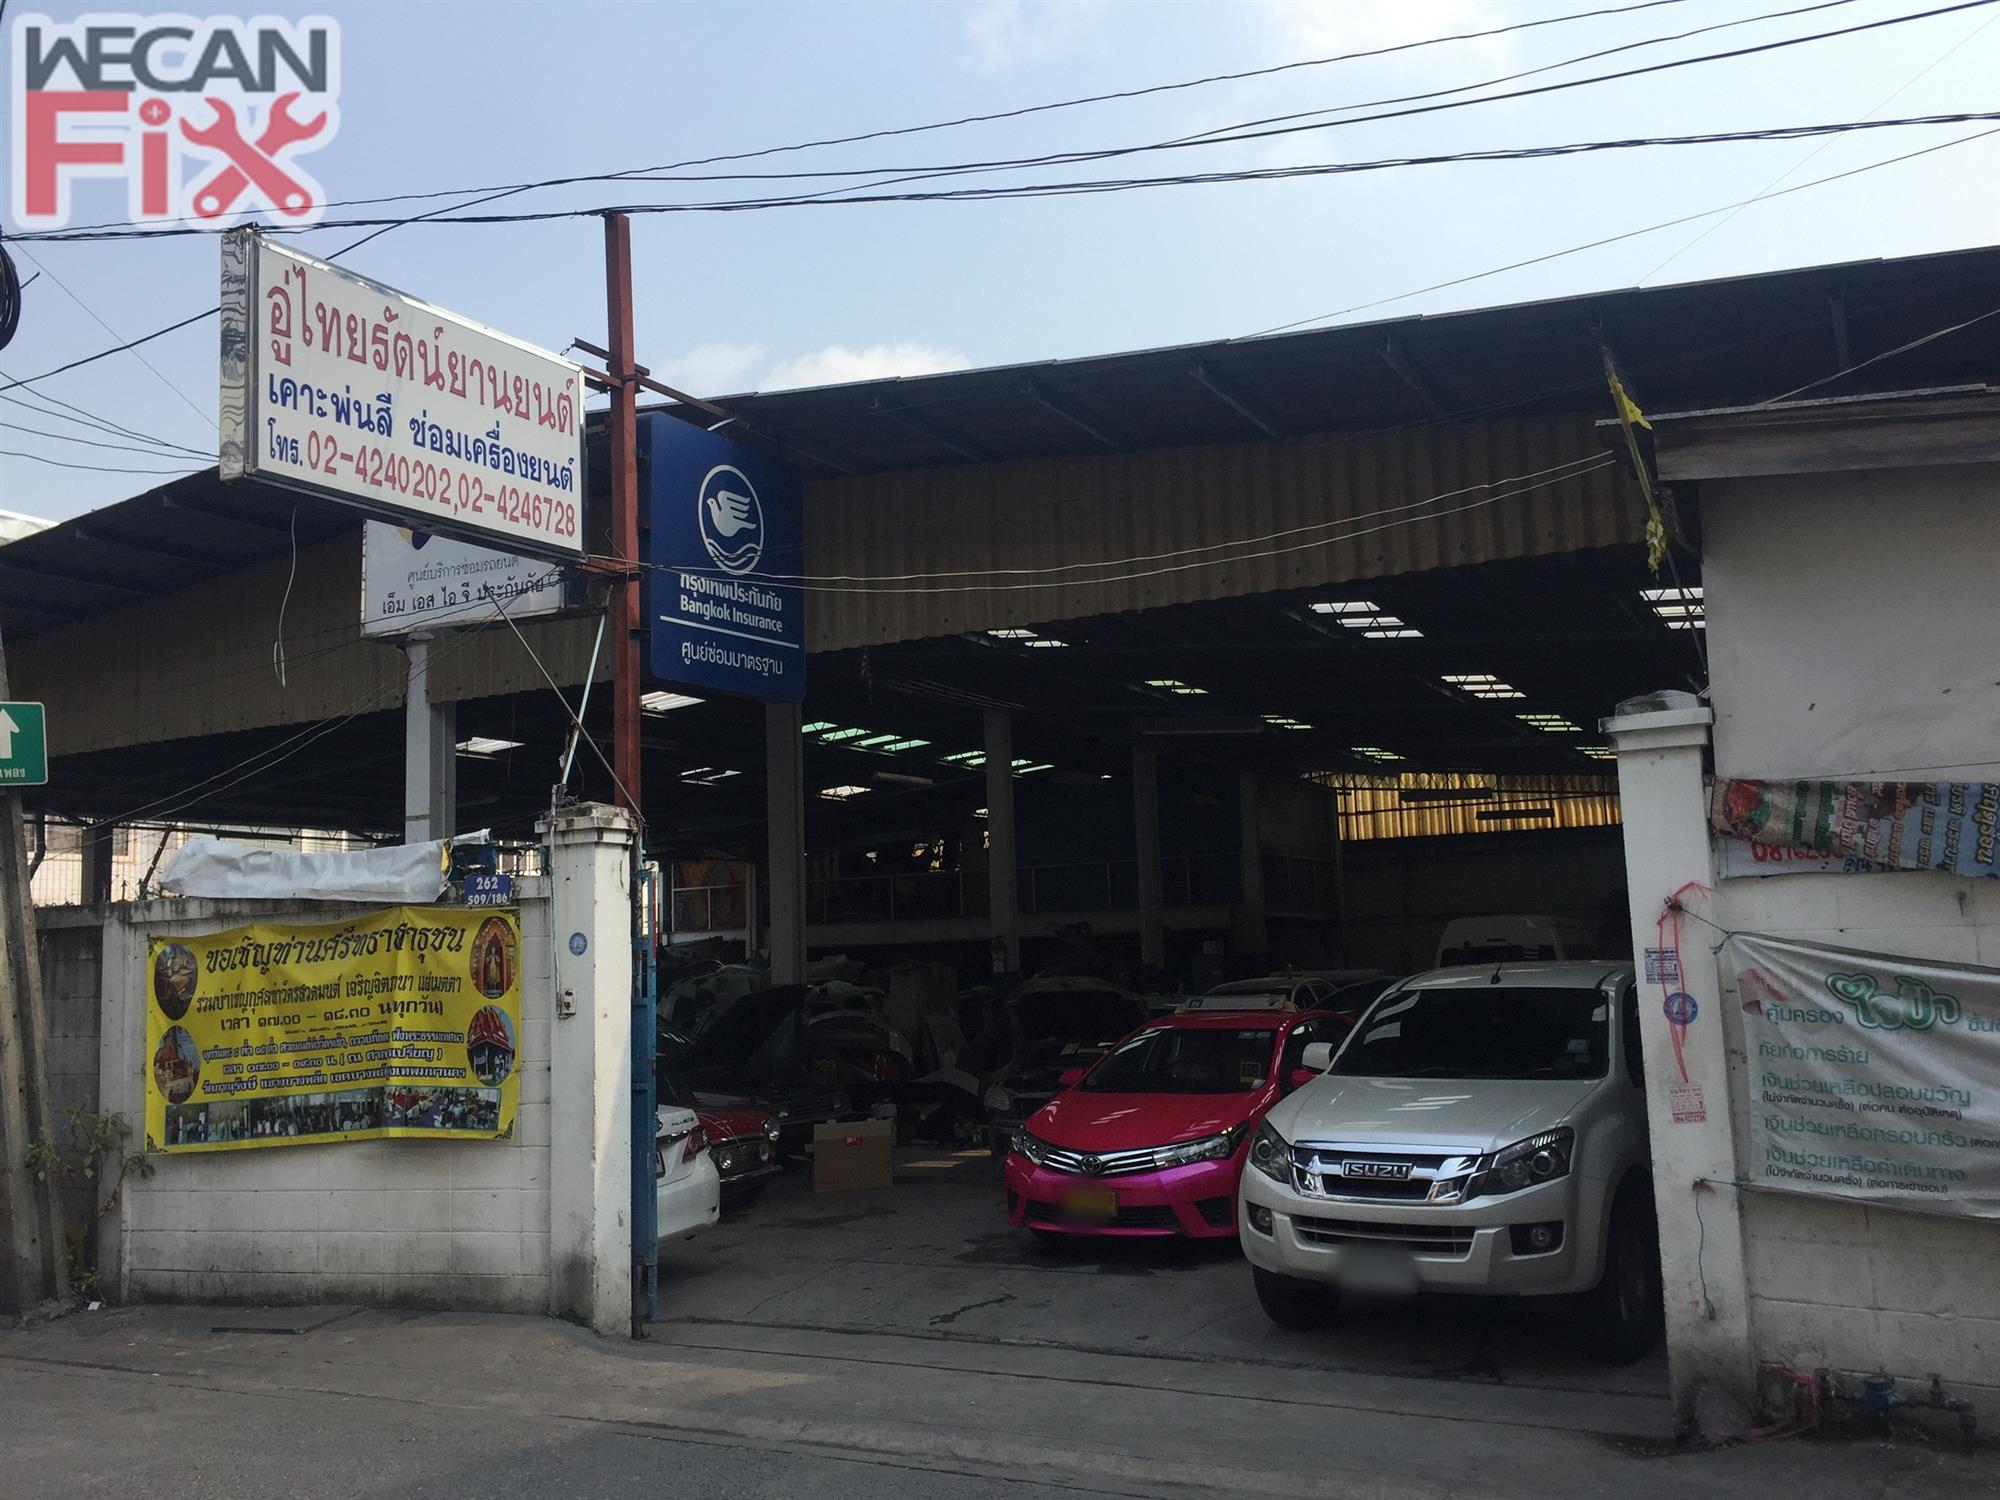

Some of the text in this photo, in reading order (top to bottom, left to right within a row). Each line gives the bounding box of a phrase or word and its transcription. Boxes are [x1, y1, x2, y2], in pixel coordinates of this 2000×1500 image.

[267, 263, 575, 437] อู่ไทยรัตน์ยานยนต์
[269, 373, 575, 492] เคาะพ่นสี ซ่อมเครื่องยนต์
[267, 417, 576, 538] โทร. 02-4240202,02-4246728
[382, 571, 545, 615] เอ็ม เอส ไอ จี ประกันภัย
[680, 573, 783, 612] กรุงเทพประกันภัย
[680, 594, 783, 632] Bangkok Insurance
[682, 641, 783, 676] ศูนย์ซ่อมมาตรฐาน
[467, 893, 509, 906] 509/186
[476, 876, 499, 891] 262
[221, 1015, 251, 1031] เวลา
[1765, 1004, 1845, 1029] คุ้มครอง
[1758, 1040, 1870, 1065] ภัยก่อการร้าย
[1762, 1072, 1971, 1107] เงินช่วยเหลือปลอบขวัญ
[1764, 1114, 1967, 1149] เงินช่วยเหลือครอบครัว
[1344, 1163, 1407, 1178] ISUZU
[1765, 1148, 1966, 1182] เงินช่วยเหลือค่าเดินทาง
